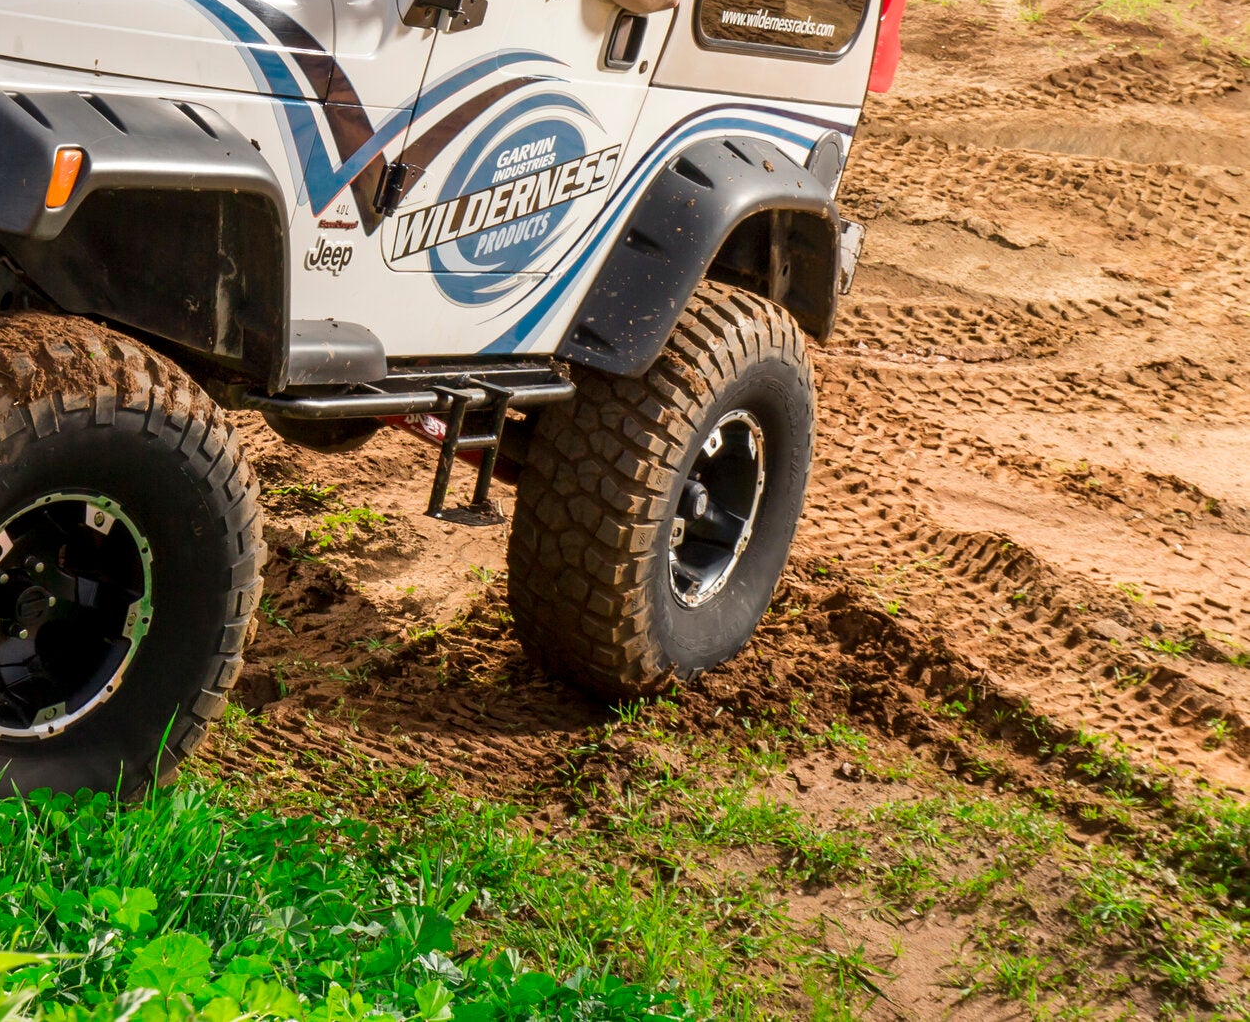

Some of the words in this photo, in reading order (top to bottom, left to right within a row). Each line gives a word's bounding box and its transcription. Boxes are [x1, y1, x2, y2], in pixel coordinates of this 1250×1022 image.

[721, 8, 835, 37] www.wildernessracks.com
[491, 152, 557, 183] INDUSTRIES
[496, 135, 557, 168] GARVIN
[393, 149, 619, 260] WILDERNESS
[473, 213, 551, 259] PRODUCTS
[308, 237, 353, 272] Jeep
